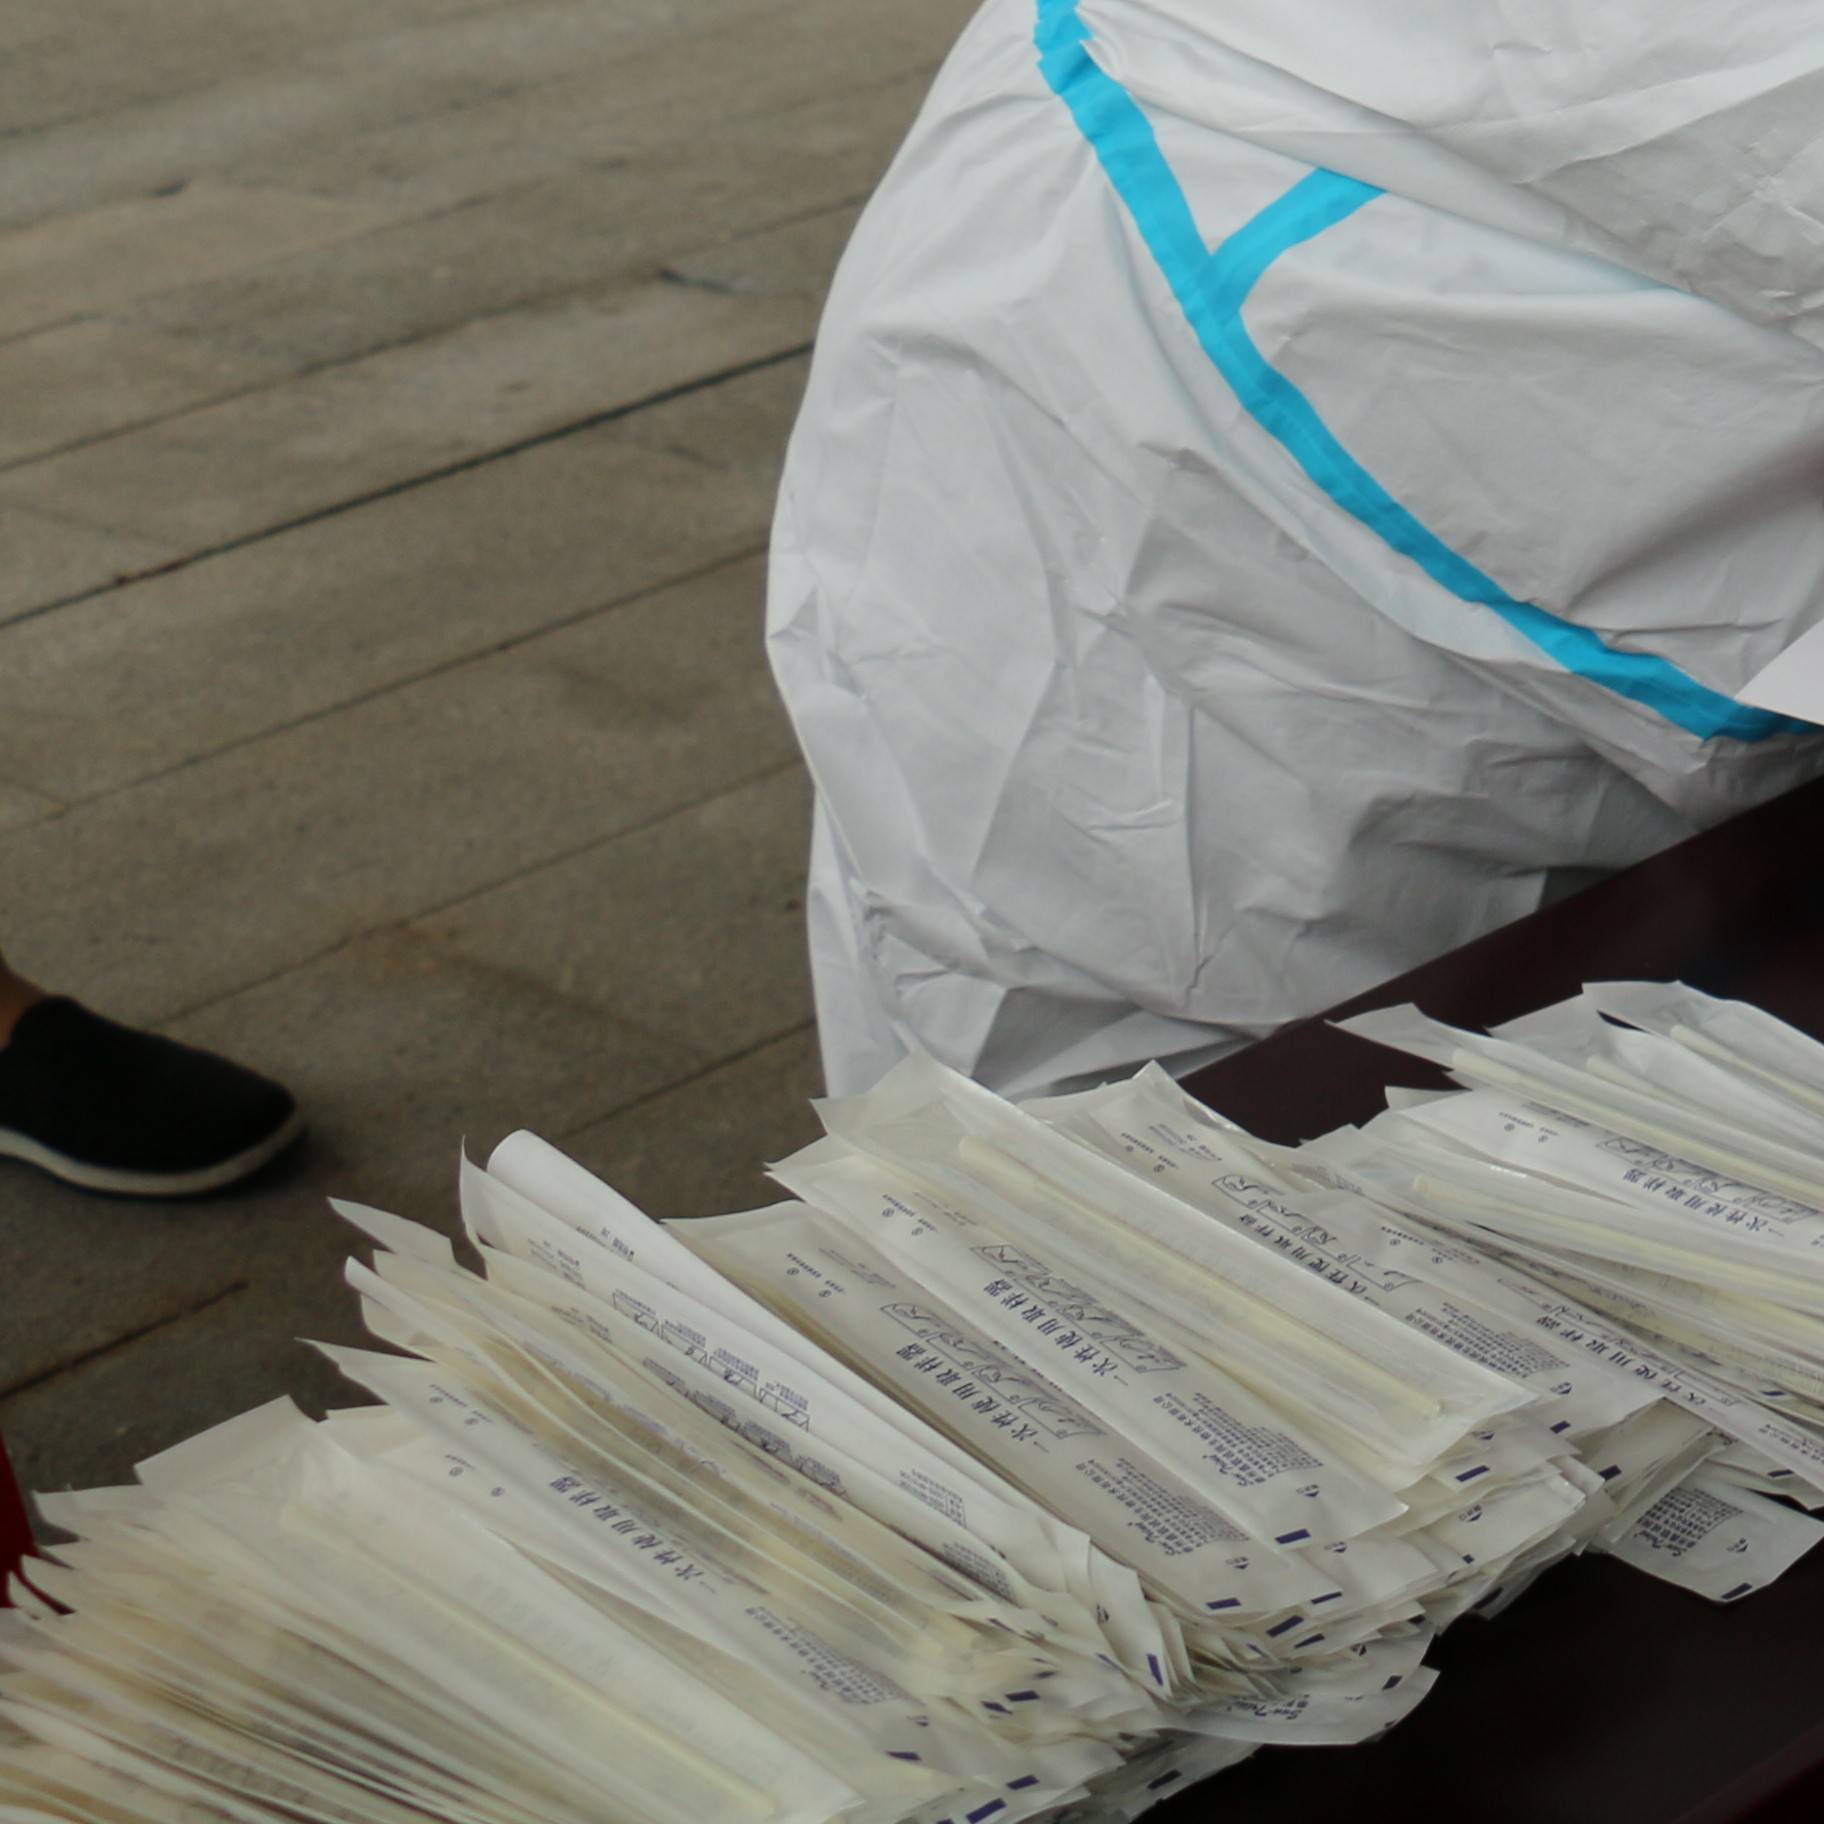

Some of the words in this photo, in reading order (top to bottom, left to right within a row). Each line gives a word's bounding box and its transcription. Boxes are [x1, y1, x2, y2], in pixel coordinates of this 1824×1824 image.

[983, 1278, 1129, 1387] 一次性使用取样器
[896, 1343, 1049, 1453] 一次性使用取样器
[549, 1476, 717, 1595] 一次性使用取样器
